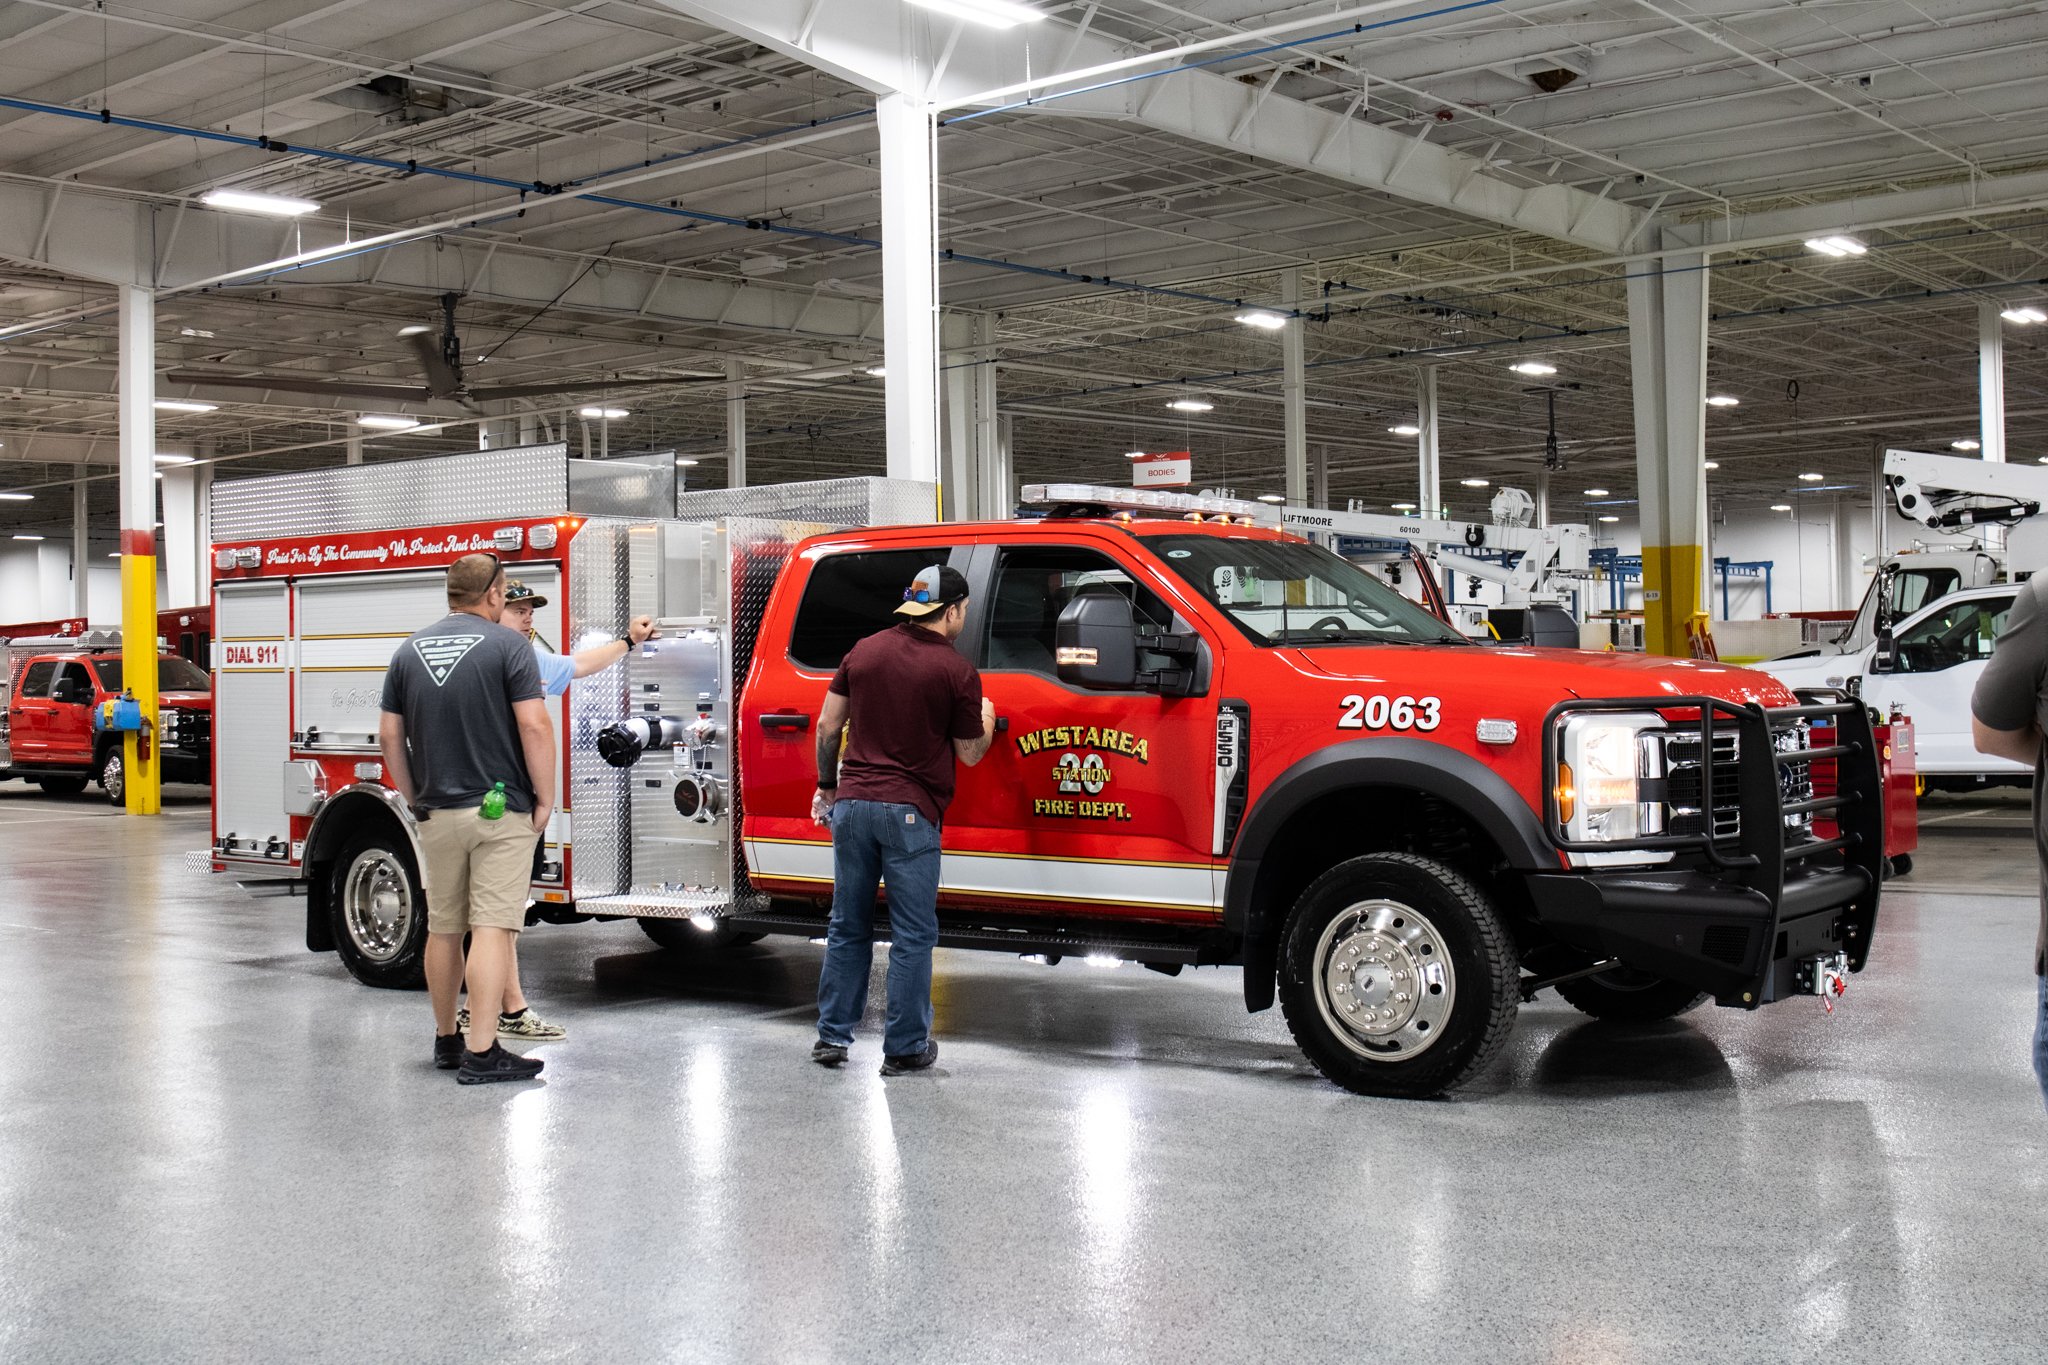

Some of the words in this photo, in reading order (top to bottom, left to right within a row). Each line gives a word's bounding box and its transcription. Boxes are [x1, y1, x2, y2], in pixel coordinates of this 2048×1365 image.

[1147, 468, 1176, 477] BODIES
[1283, 513, 1333, 527] LIFTMOORE
[1399, 526, 1421, 534] 60100
[266, 548, 290, 565] Paid
[288, 549, 307, 564] For
[307, 545, 323, 567] By
[323, 545, 339, 561] The
[340, 545, 389, 563] Community
[389, 539, 408, 558] We
[408, 537, 443, 557] Protect
[444, 535, 469, 553] And
[226, 646, 254, 664] DIAL
[257, 646, 278, 664] 911
[1337, 694, 1441, 731] 2063
[1052, 767, 1111, 782] STATION
[1034, 799, 1075, 816] FIRE
[1078, 801, 1132, 819] DEPT.
